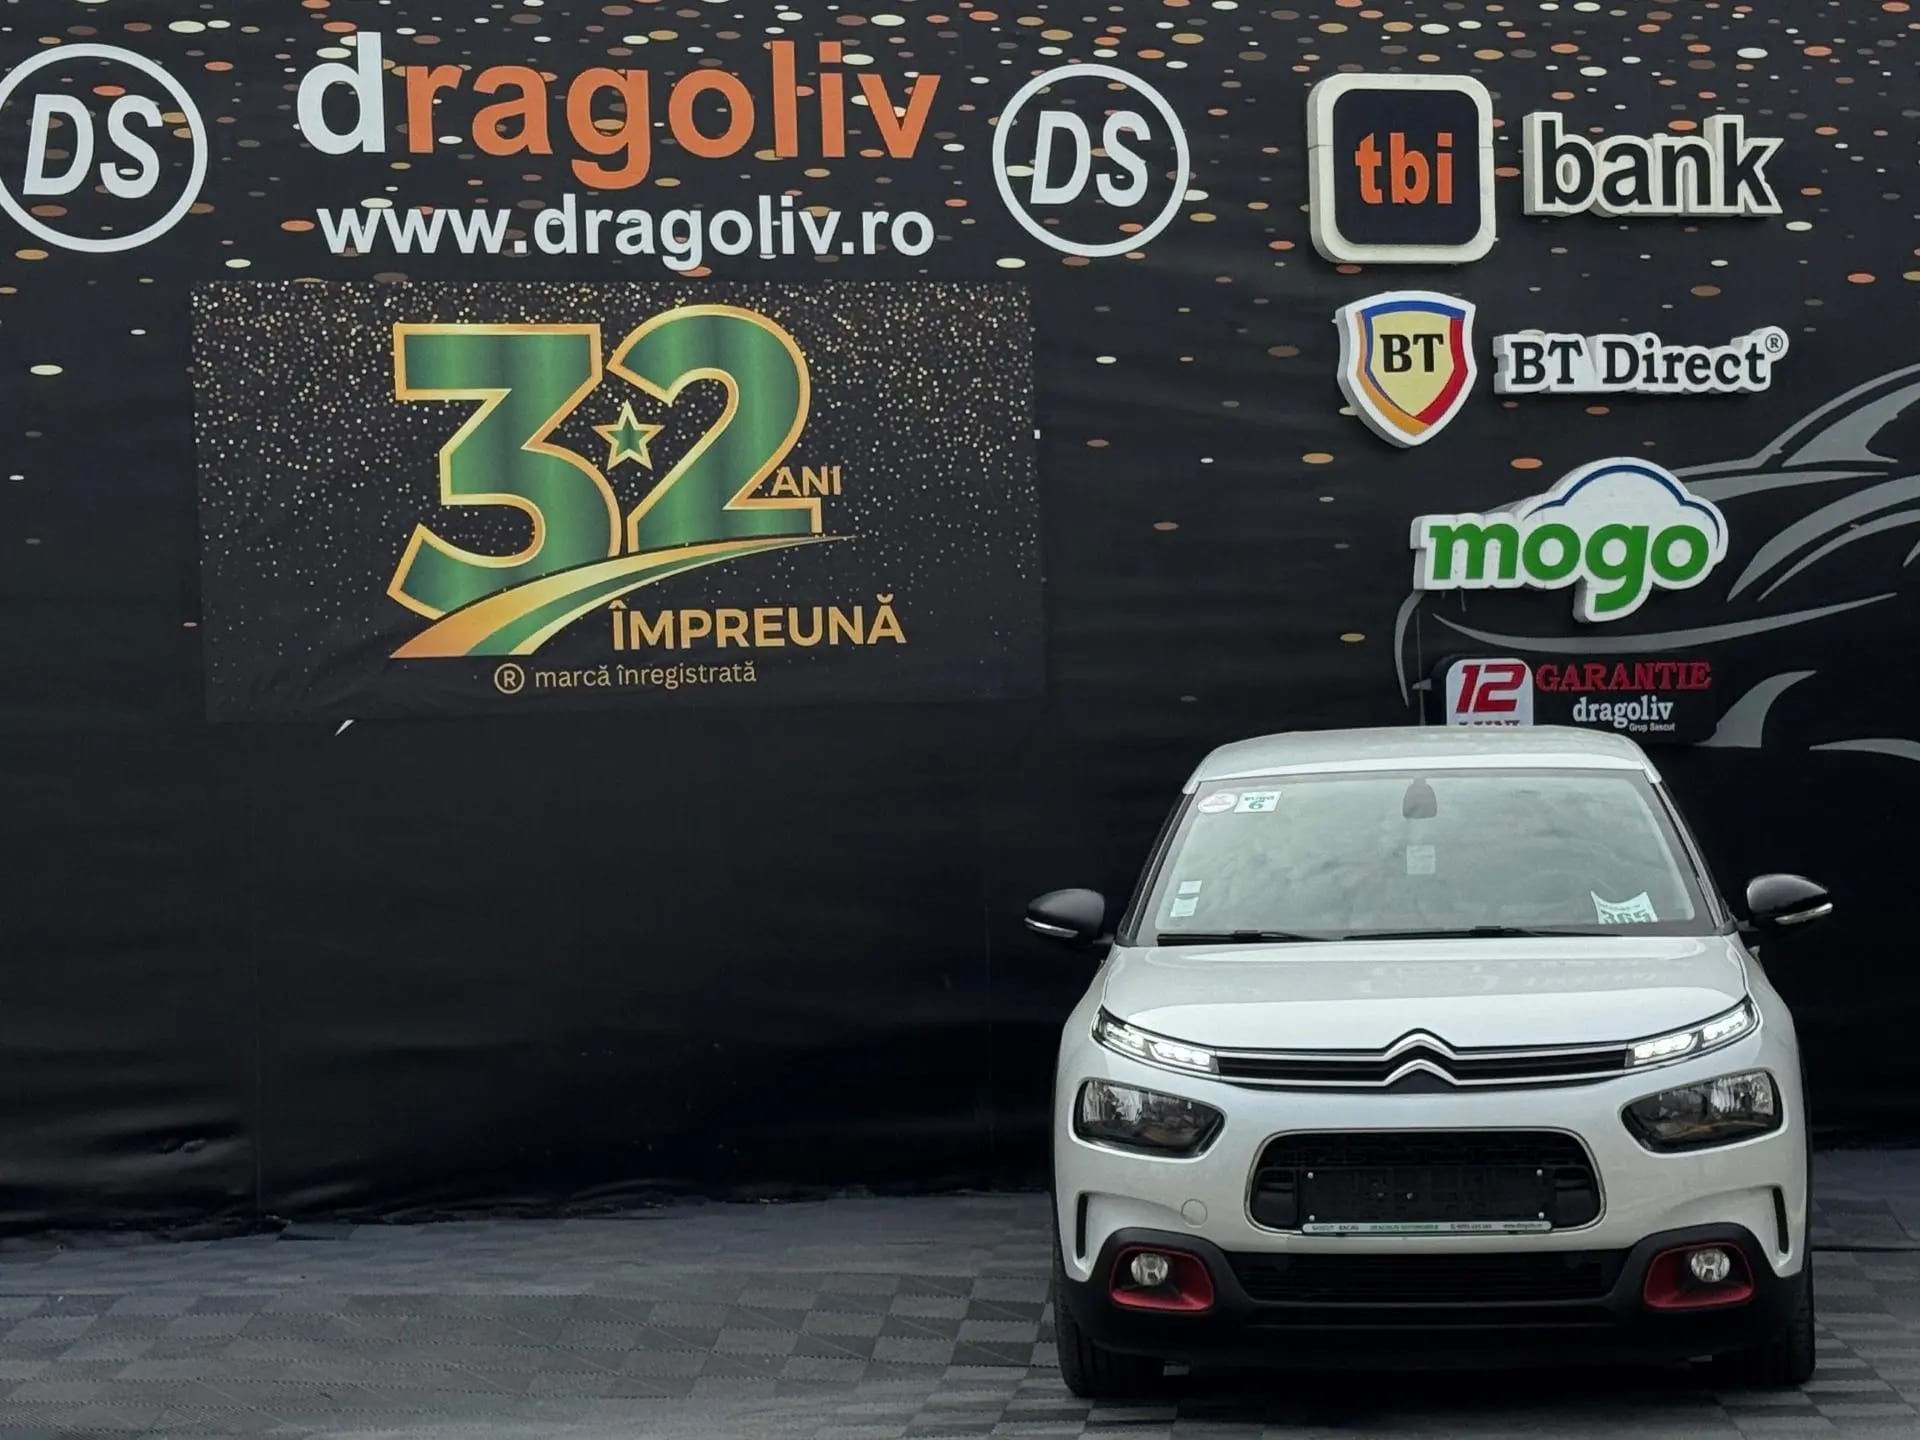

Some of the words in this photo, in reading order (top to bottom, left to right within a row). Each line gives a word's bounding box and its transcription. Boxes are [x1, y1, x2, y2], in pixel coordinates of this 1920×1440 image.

[296, 31, 940, 190] dragoliv
[22, 93, 164, 201] DS
[1030, 109, 1153, 208] DS
[1354, 132, 1453, 206] tbi
[1540, 116, 1781, 211] bank
[317, 193, 936, 272] www.dragoliv.ro
[1380, 333, 1444, 375] BT
[1511, 339, 1584, 390] BT
[387, 303, 823, 621] 32
[771, 465, 842, 497] ANI
[1429, 523, 1710, 613] mogo
[608, 593, 907, 651] ÎMPREUNĂ
[535, 663, 611, 688] marcă
[616, 660, 758, 691] înregistrată
[1456, 663, 1527, 714] 12
[1535, 661, 1712, 692] GARANTIE
[1572, 695, 1674, 729] dragoliv
